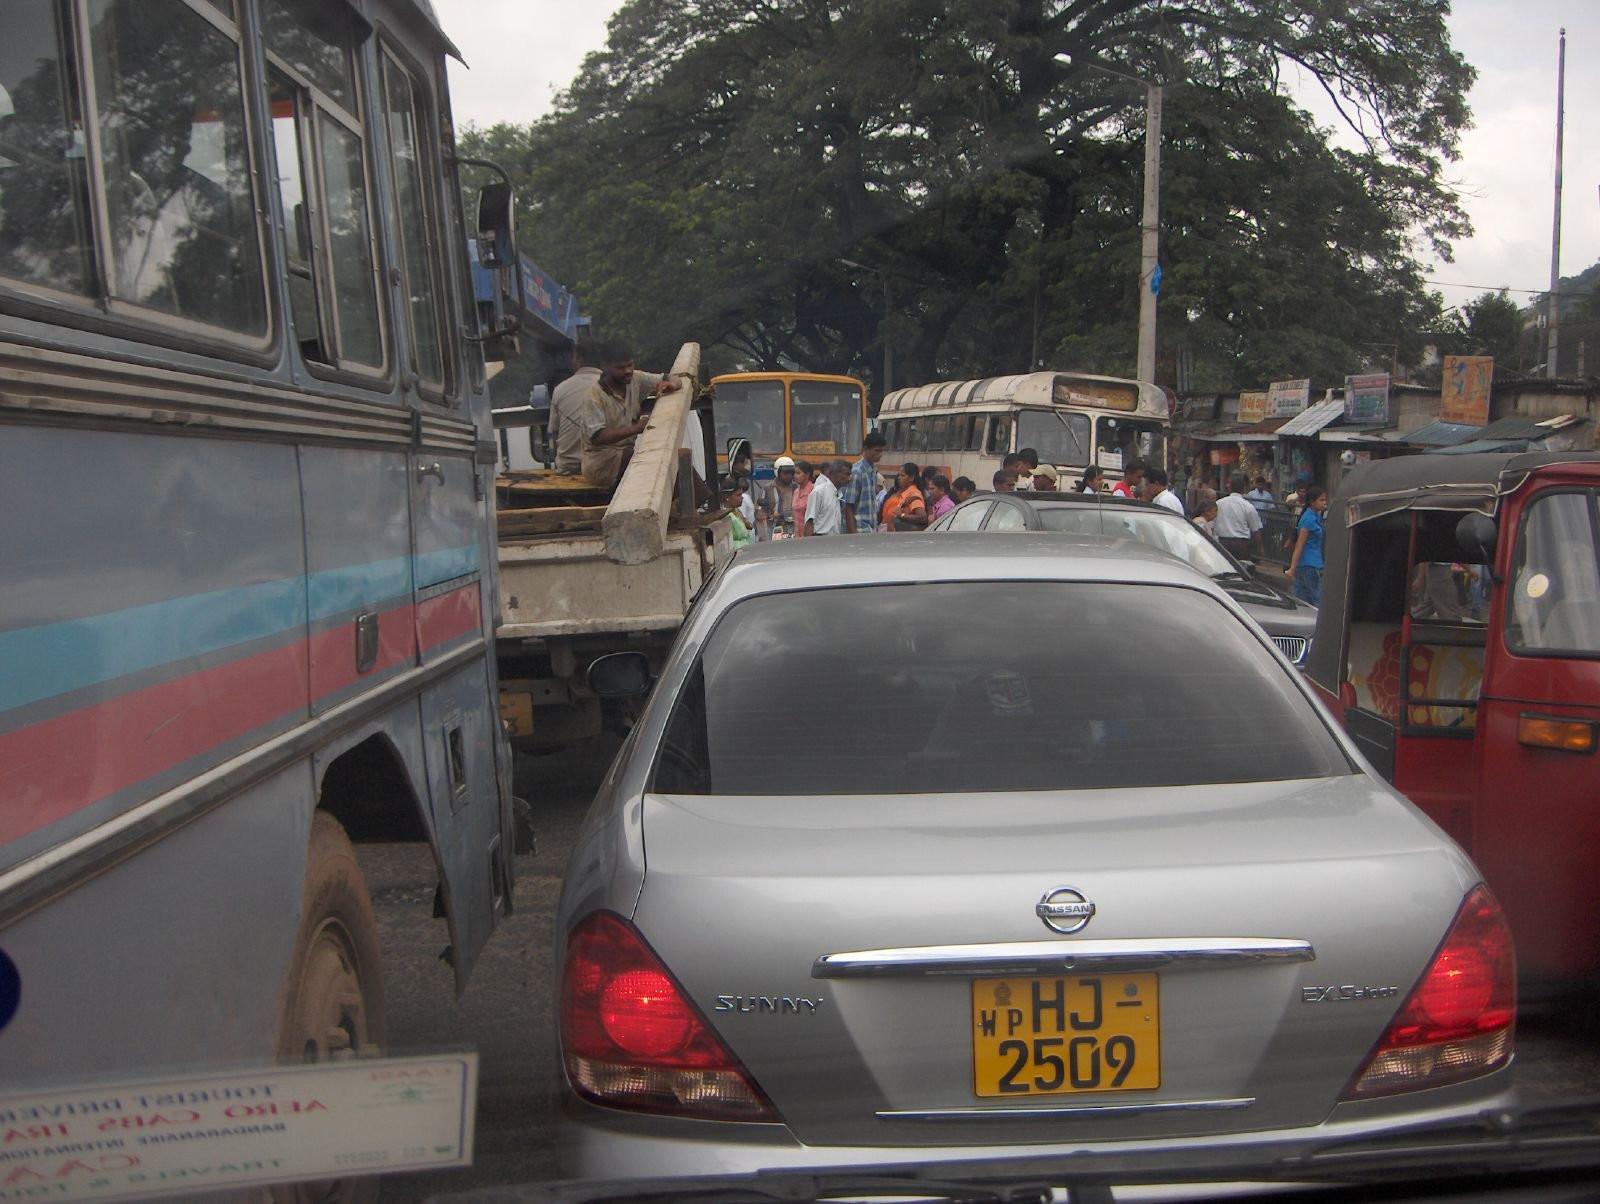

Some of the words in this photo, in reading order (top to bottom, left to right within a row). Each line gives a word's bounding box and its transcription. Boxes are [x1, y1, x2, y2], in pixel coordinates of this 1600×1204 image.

[1043, 903, 1089, 914] NISSAN
[1302, 985, 1335, 1002] EX
[715, 995, 824, 1014] SUNNY
[1032, 979, 1102, 1032] HJ
[999, 1036, 1135, 1092] 2509
